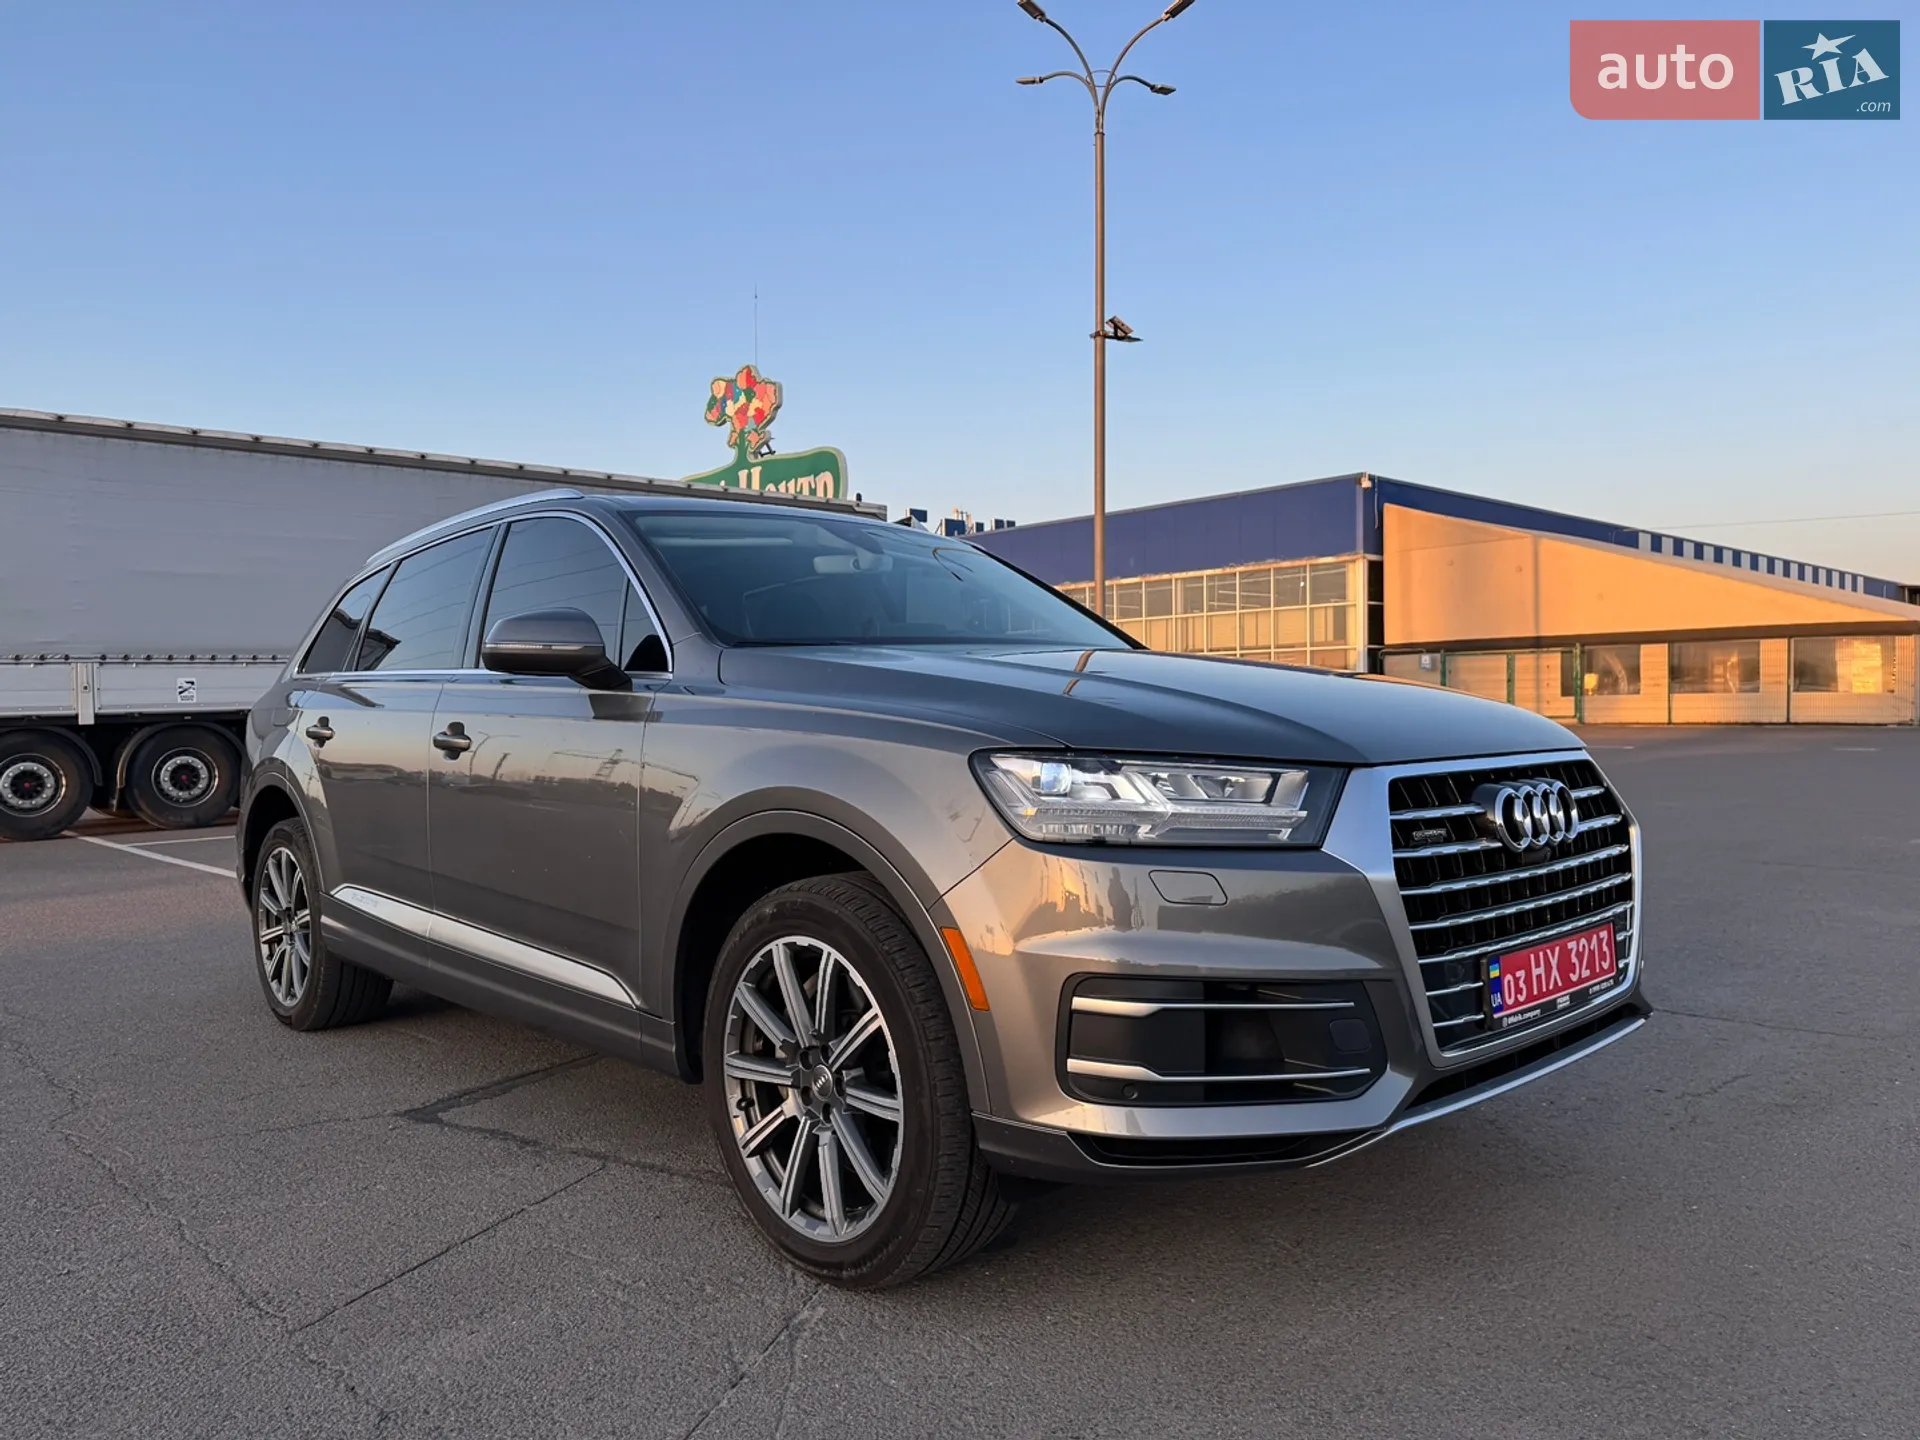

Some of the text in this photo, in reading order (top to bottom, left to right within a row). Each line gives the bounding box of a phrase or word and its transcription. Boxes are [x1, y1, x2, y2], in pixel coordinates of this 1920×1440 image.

[1503, 969, 1527, 1005] 03
[1566, 930, 1611, 982] 3213
[1490, 991, 1503, 1007] UA
